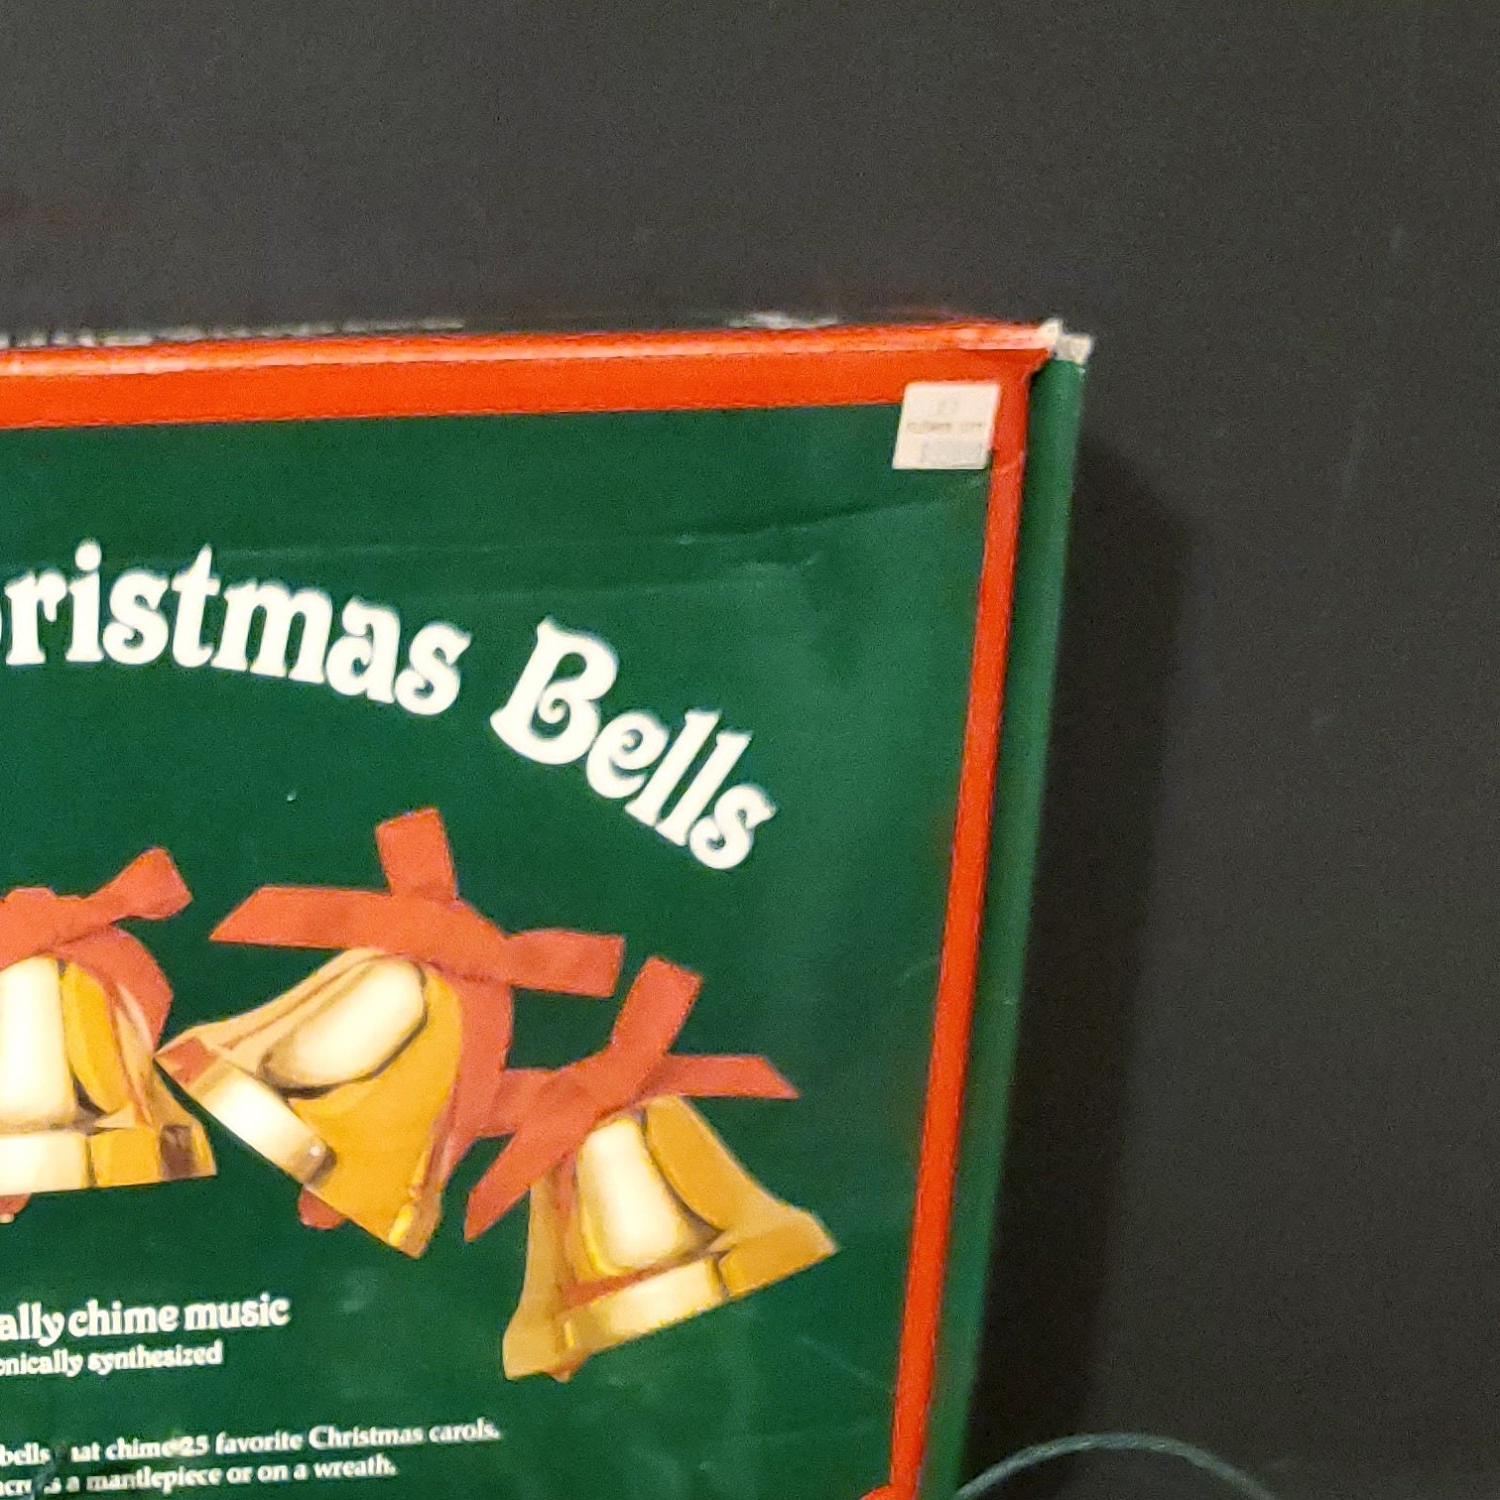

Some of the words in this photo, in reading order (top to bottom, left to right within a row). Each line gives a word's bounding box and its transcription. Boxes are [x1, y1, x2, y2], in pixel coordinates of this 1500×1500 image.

[490, 618, 776, 869] Bells
[68, 1299, 179, 1337] chime
[184, 1292, 290, 1331] music
[88, 1335, 223, 1375] synthesized
[215, 1431, 304, 1454] favorite
[308, 1426, 425, 1449] Christmas
[429, 1417, 501, 1442] carols.
[66, 1476, 79, 1491] a
[87, 1466, 223, 1494] mantlepiece
[226, 1467, 252, 1483] or
[257, 1465, 289, 1482] on
[294, 1464, 308, 1480] a
[314, 1453, 396, 1478] wreath.
